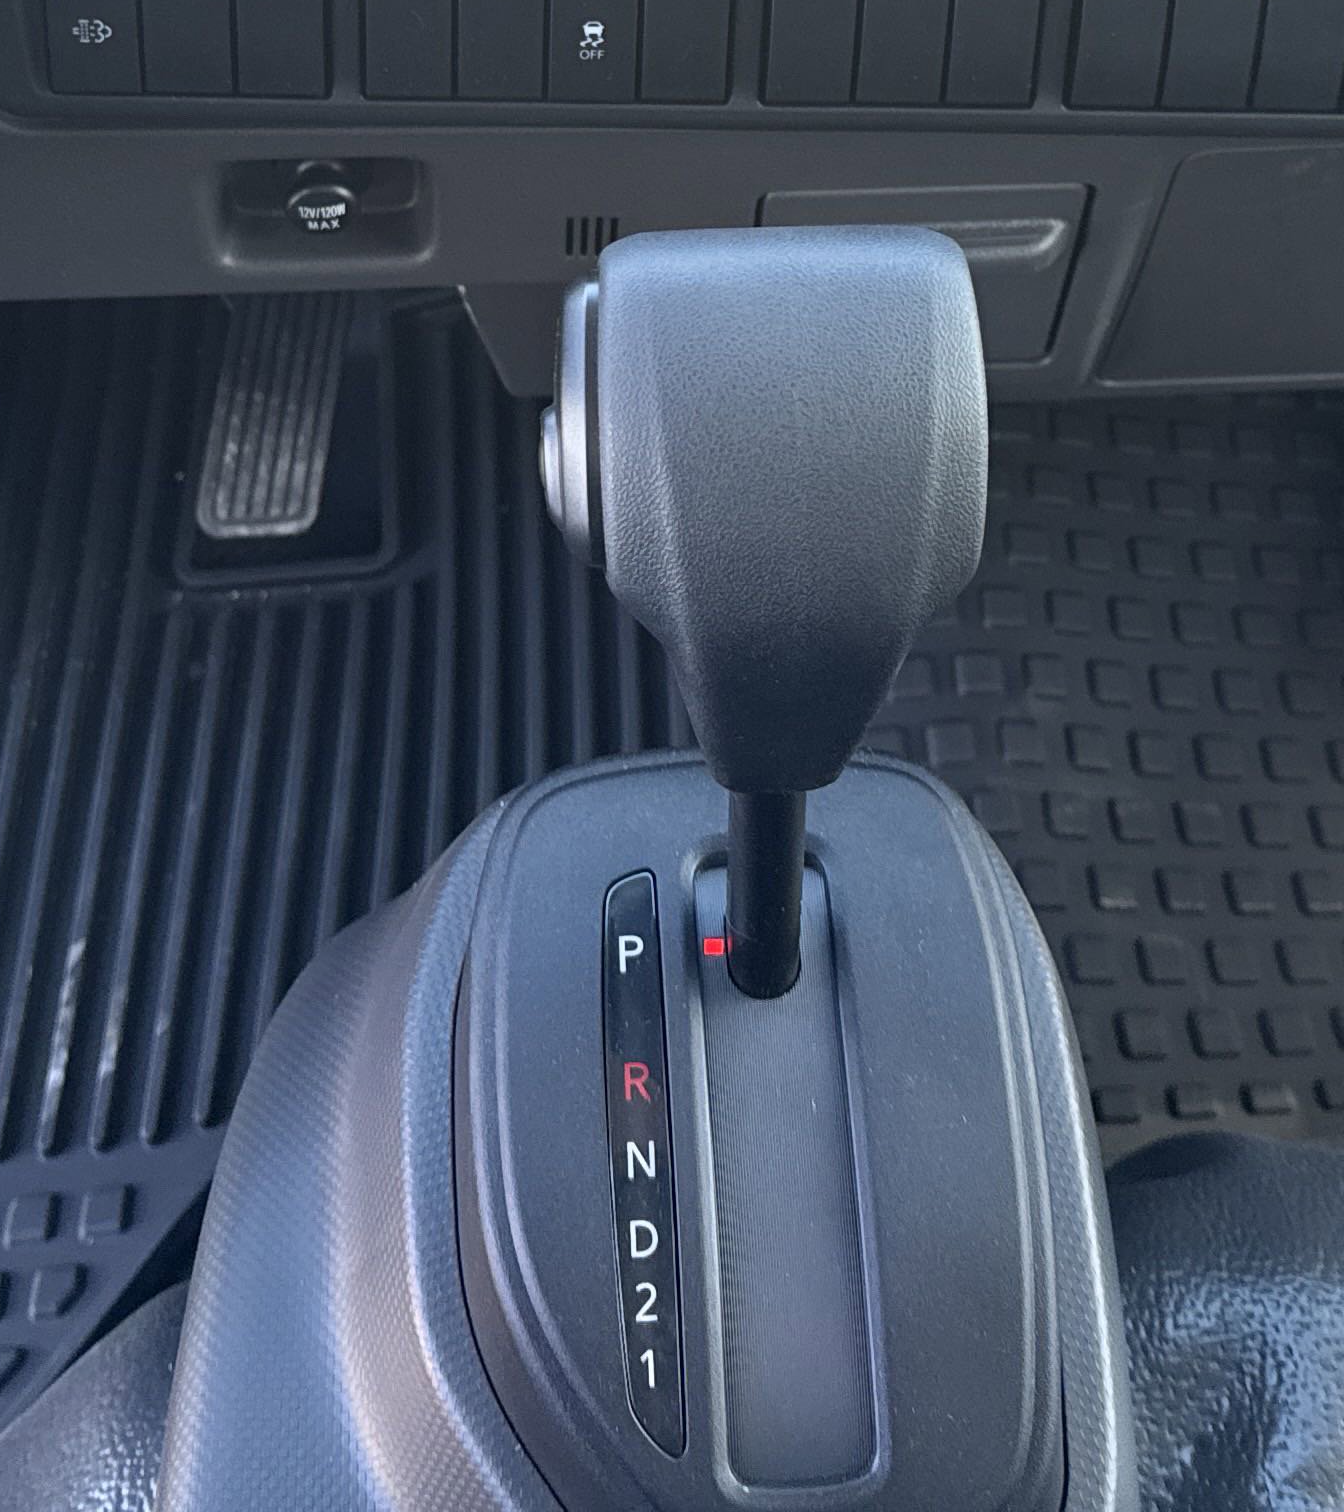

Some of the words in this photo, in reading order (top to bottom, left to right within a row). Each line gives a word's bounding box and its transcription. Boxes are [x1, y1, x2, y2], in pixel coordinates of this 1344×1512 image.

[579, 49, 606, 60] OFF
[298, 202, 346, 218] 12V/120W
[308, 219, 340, 230] MAX
[617, 934, 644, 974] P
[623, 1061, 652, 1102] R
[626, 1140, 657, 1179] N
[629, 1219, 659, 1259] D
[634, 1282, 659, 1324] 2
[640, 1350, 656, 1389] 1
